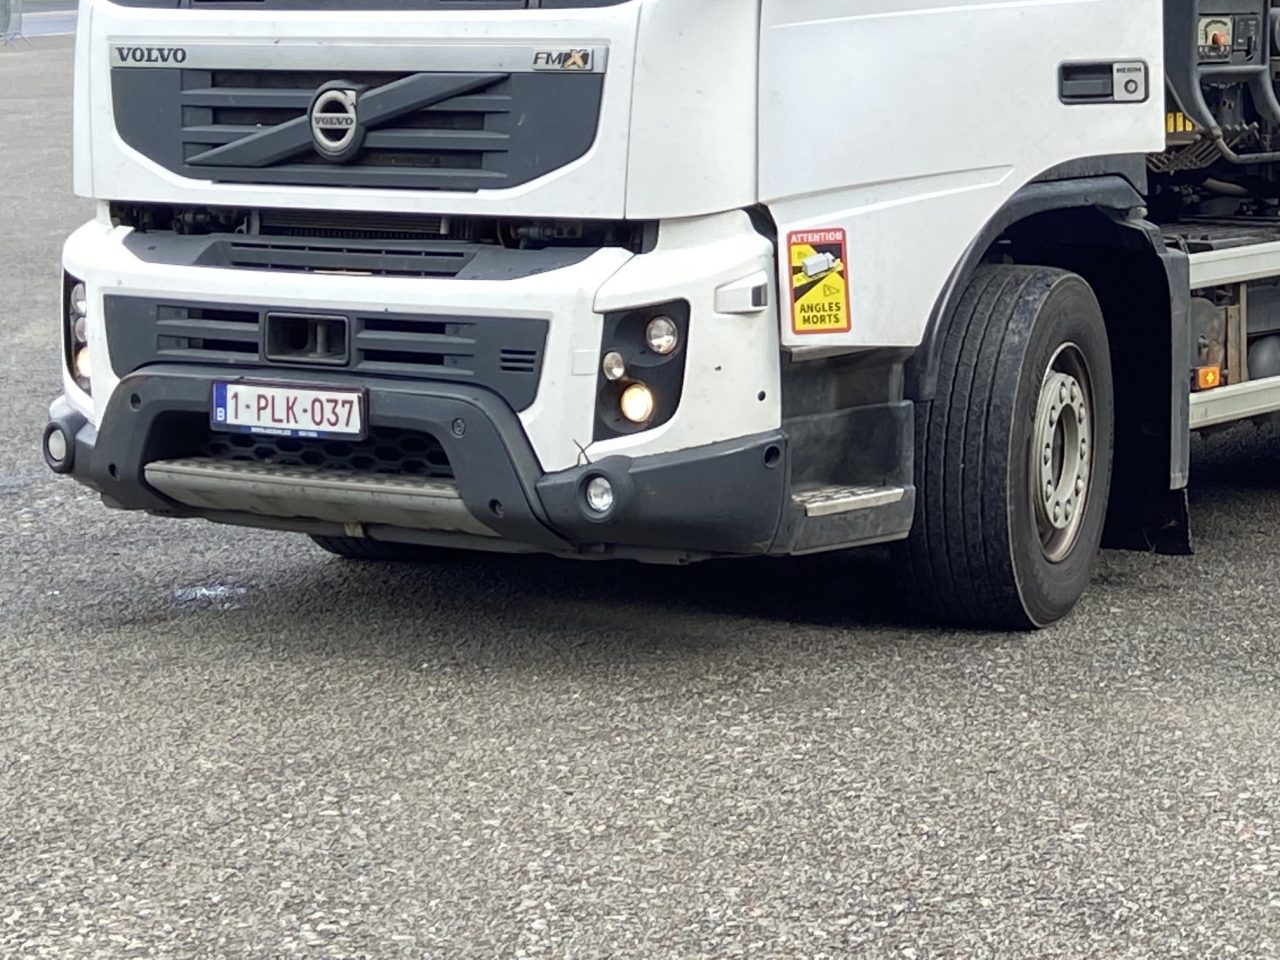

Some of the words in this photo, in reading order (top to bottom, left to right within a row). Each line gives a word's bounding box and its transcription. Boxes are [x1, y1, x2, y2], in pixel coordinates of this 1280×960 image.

[115, 47, 187, 63] VOLVO
[533, 49, 590, 69] FMX
[314, 116, 354, 126] VOLVO
[790, 231, 843, 243] ATTENTION
[800, 302, 842, 314] ANGLES
[802, 313, 841, 325] MORTS
